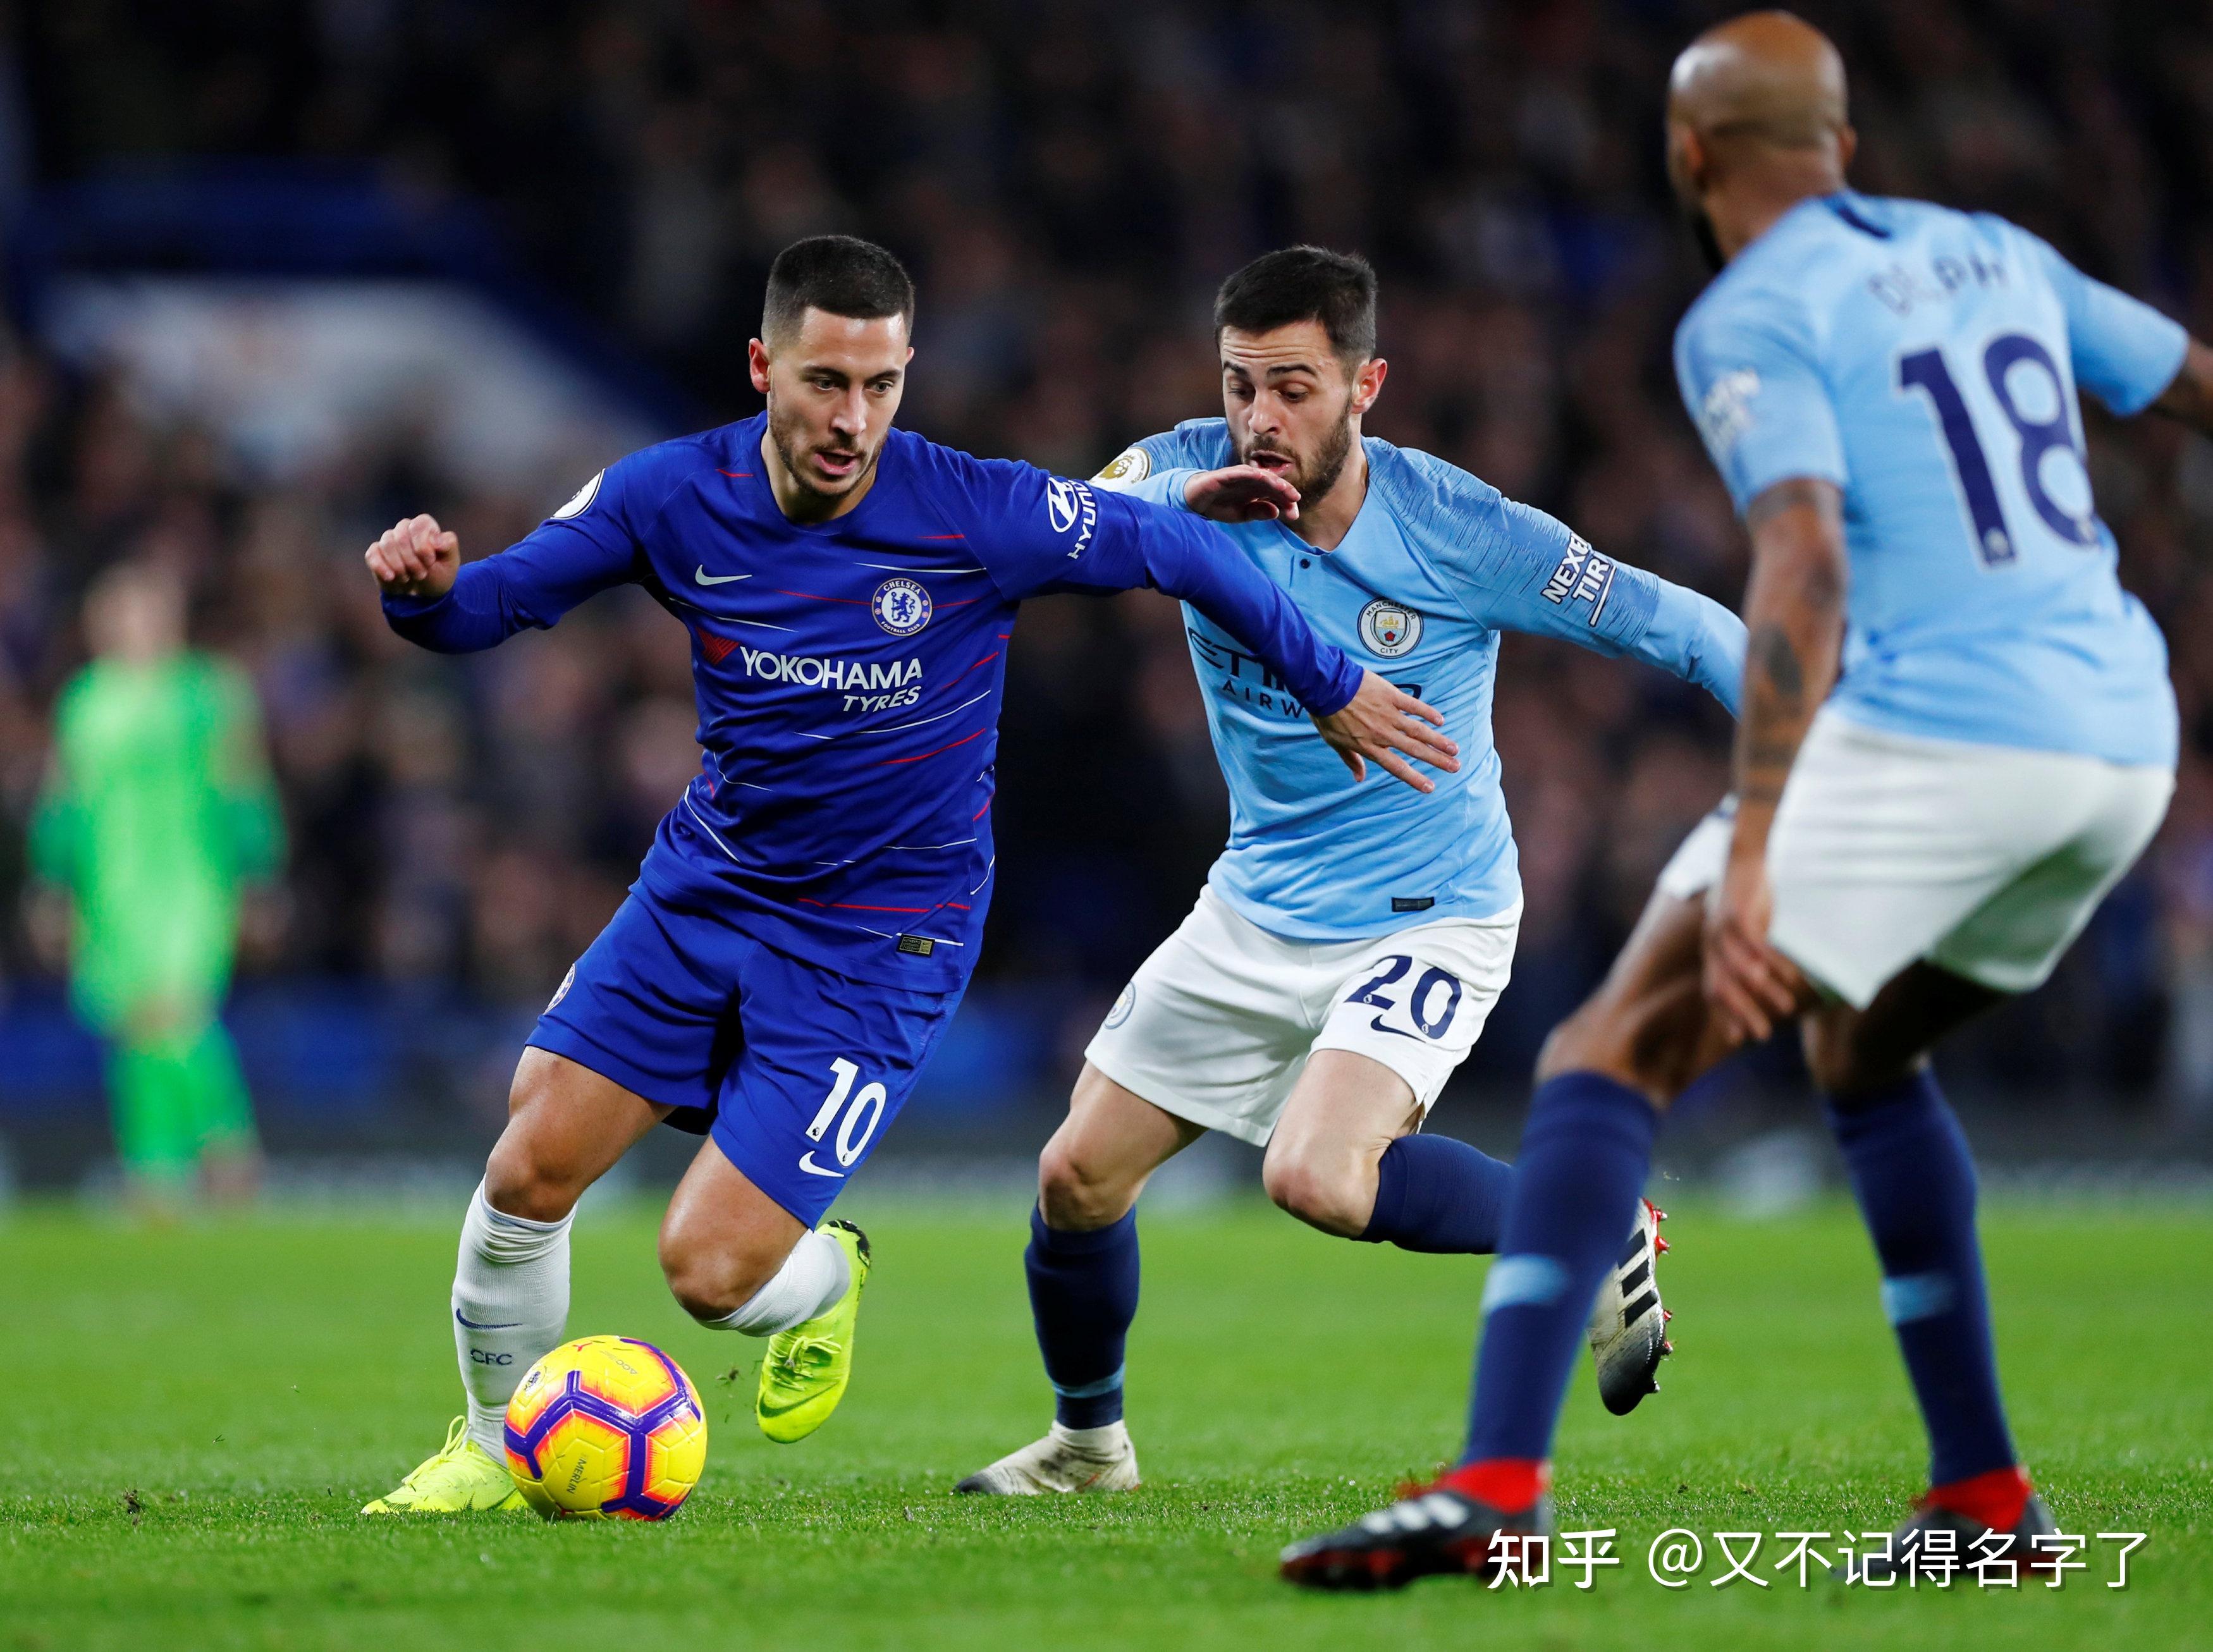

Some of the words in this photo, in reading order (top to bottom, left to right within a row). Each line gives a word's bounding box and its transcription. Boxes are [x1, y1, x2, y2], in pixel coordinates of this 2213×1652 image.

[1900, 334, 2100, 565] 18
[1067, 480, 1096, 560] HYUND
[883, 581, 921, 595] CHELSEA
[1542, 532, 1590, 604] NEXE
[1572, 551, 1610, 602] TIR
[881, 621, 905, 633] FOOTBALL
[907, 623, 921, 632] CLUB
[740, 646, 923, 690] YOKOHAMA
[842, 686, 921, 712] TYRES
[1222, 680, 1304, 719] AIRW
[1343, 955, 1462, 1040] 20
[805, 1056, 886, 1167] 10
[470, 1349, 512, 1366] CFC
[567, 1457, 587, 1494] MERLIN
